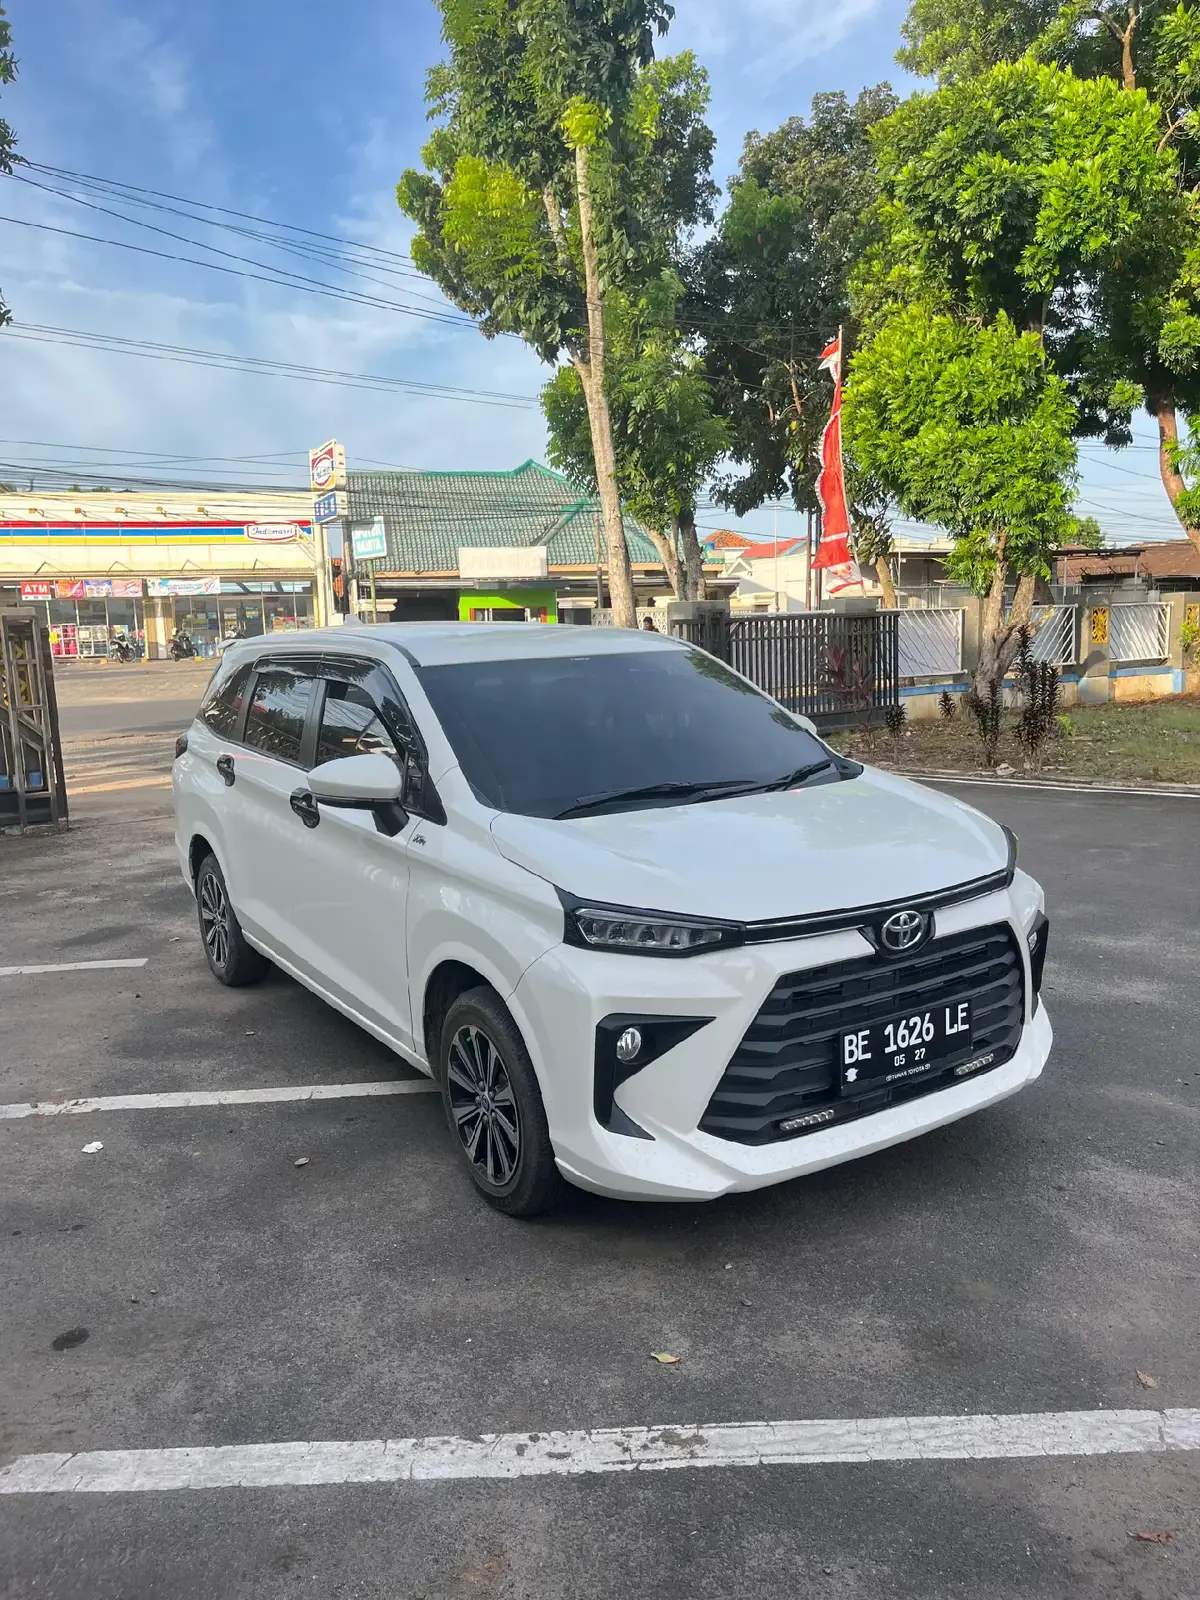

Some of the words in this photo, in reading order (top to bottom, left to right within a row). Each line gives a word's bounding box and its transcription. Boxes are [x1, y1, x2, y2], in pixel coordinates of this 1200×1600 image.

[24, 584, 48, 593] ATM
[844, 1030, 871, 1064] BE
[884, 1012, 934, 1053] 1626
[945, 1003, 969, 1035] LE
[894, 1053, 905, 1066] 05
[914, 1047, 926, 1060] 27
